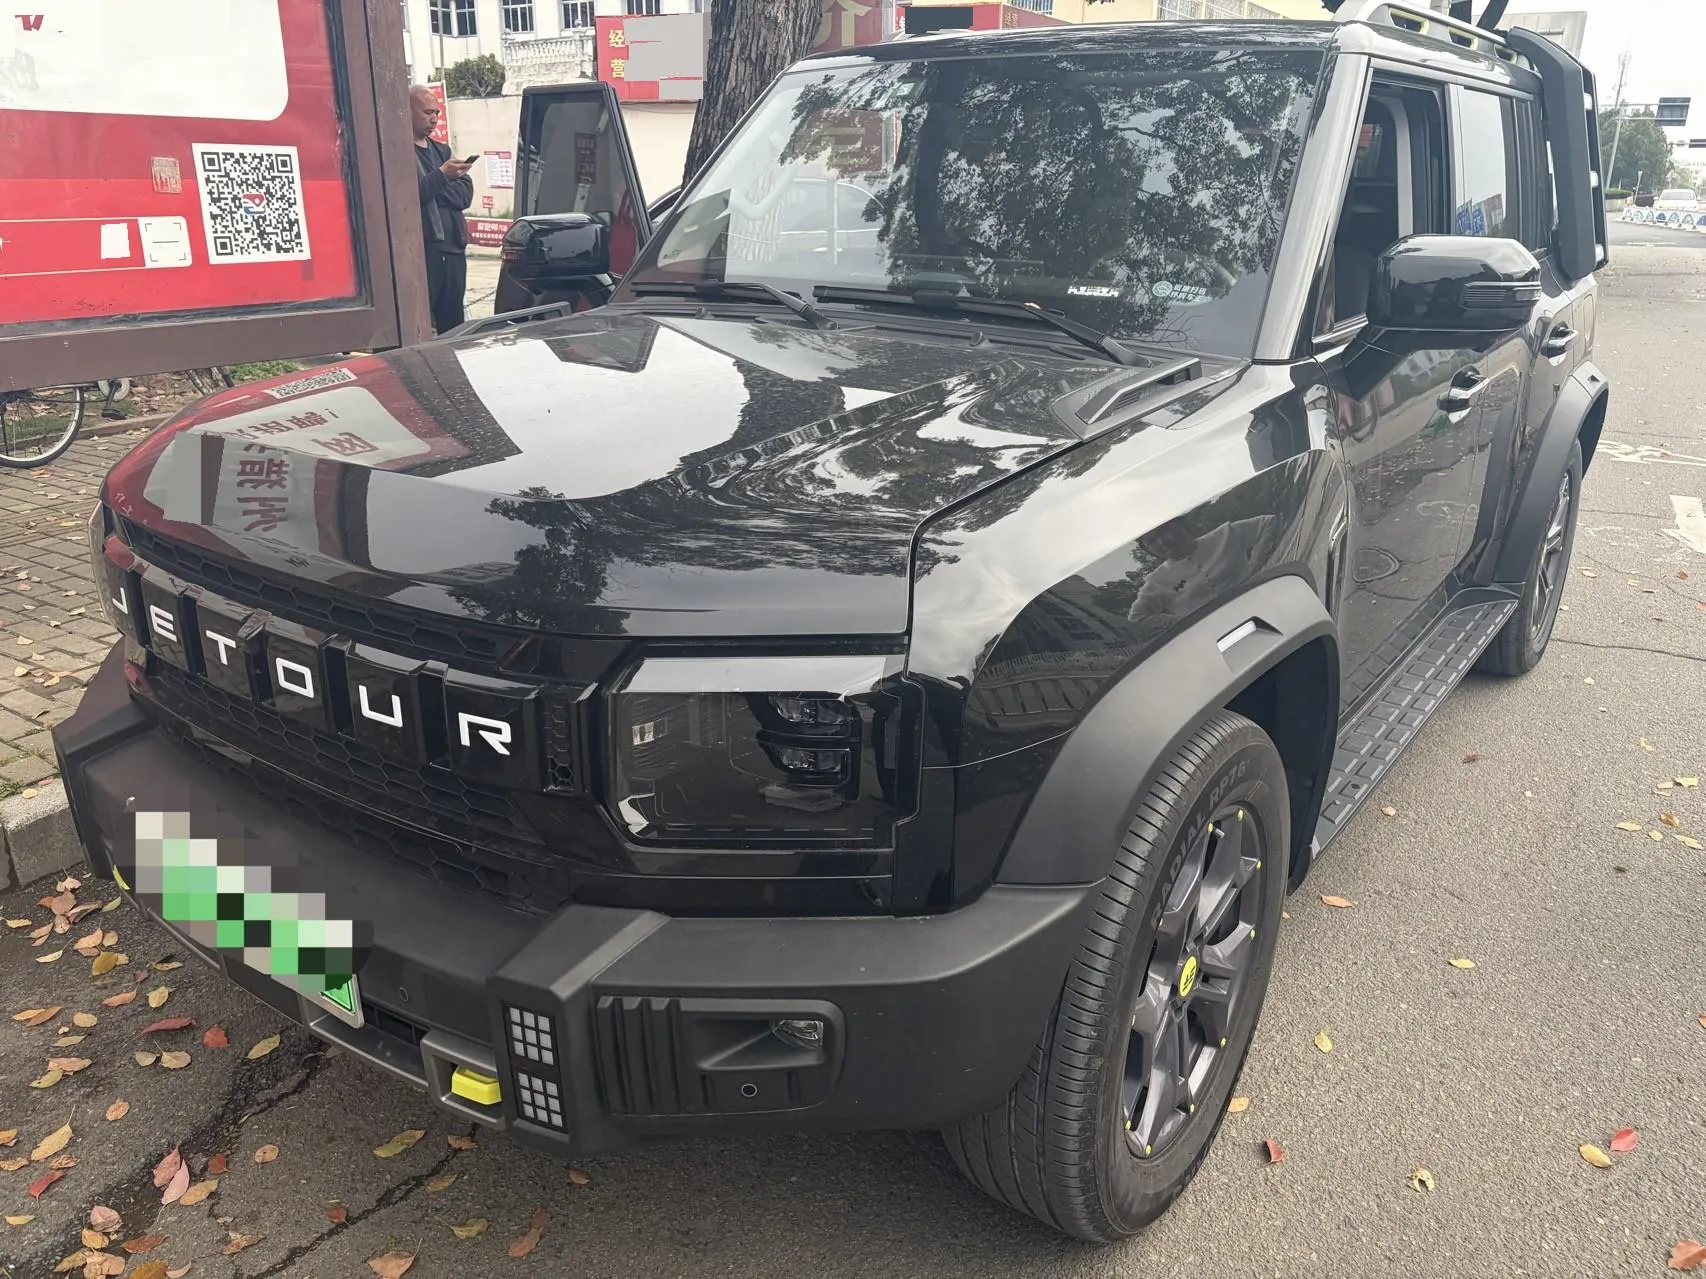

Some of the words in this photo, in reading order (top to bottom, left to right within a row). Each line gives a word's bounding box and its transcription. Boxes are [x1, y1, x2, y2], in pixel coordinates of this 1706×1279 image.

[609, 29, 626, 78] 经营
[112, 588, 512, 755] JETOUR
[1151, 812, 1206, 931] RADIAL
